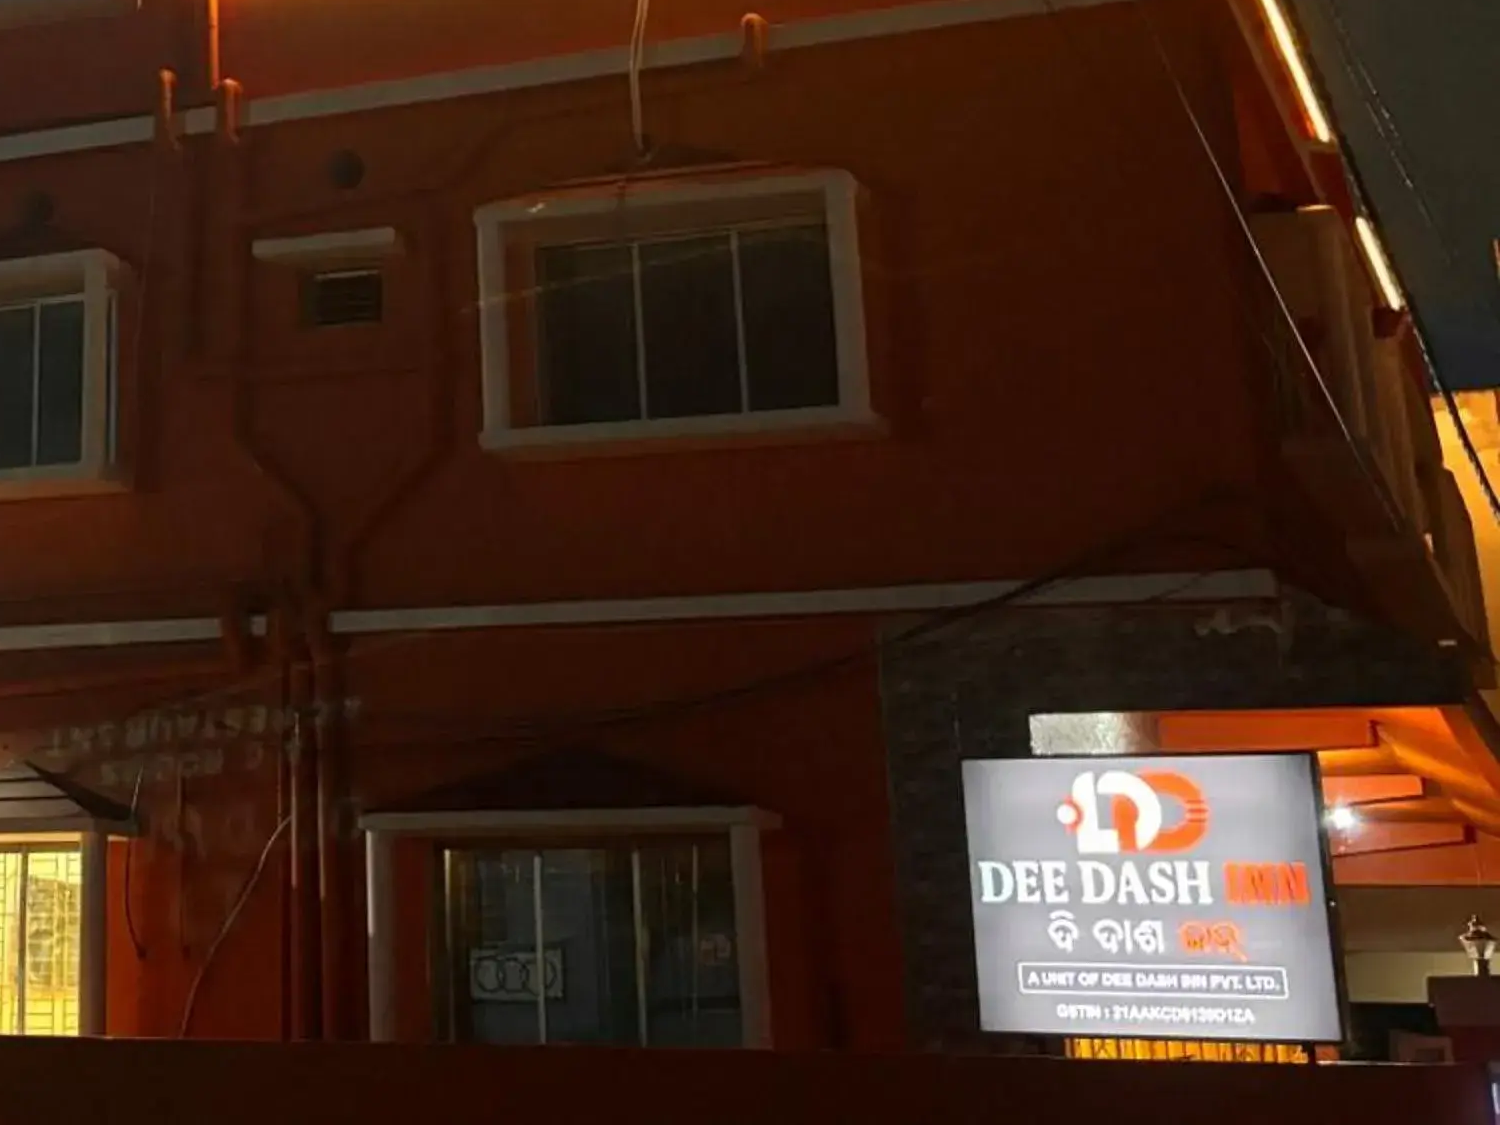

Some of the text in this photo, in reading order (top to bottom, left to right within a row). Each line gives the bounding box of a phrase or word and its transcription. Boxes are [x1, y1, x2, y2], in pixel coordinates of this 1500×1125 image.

[977, 860, 1311, 905] DEE DASH INN
[1027, 970, 1040, 986] A
[1041, 971, 1076, 987] UNIT
[1077, 971, 1099, 987] OF
[1101, 972, 1133, 987] DEE
[1135, 972, 1178, 988] DASH
